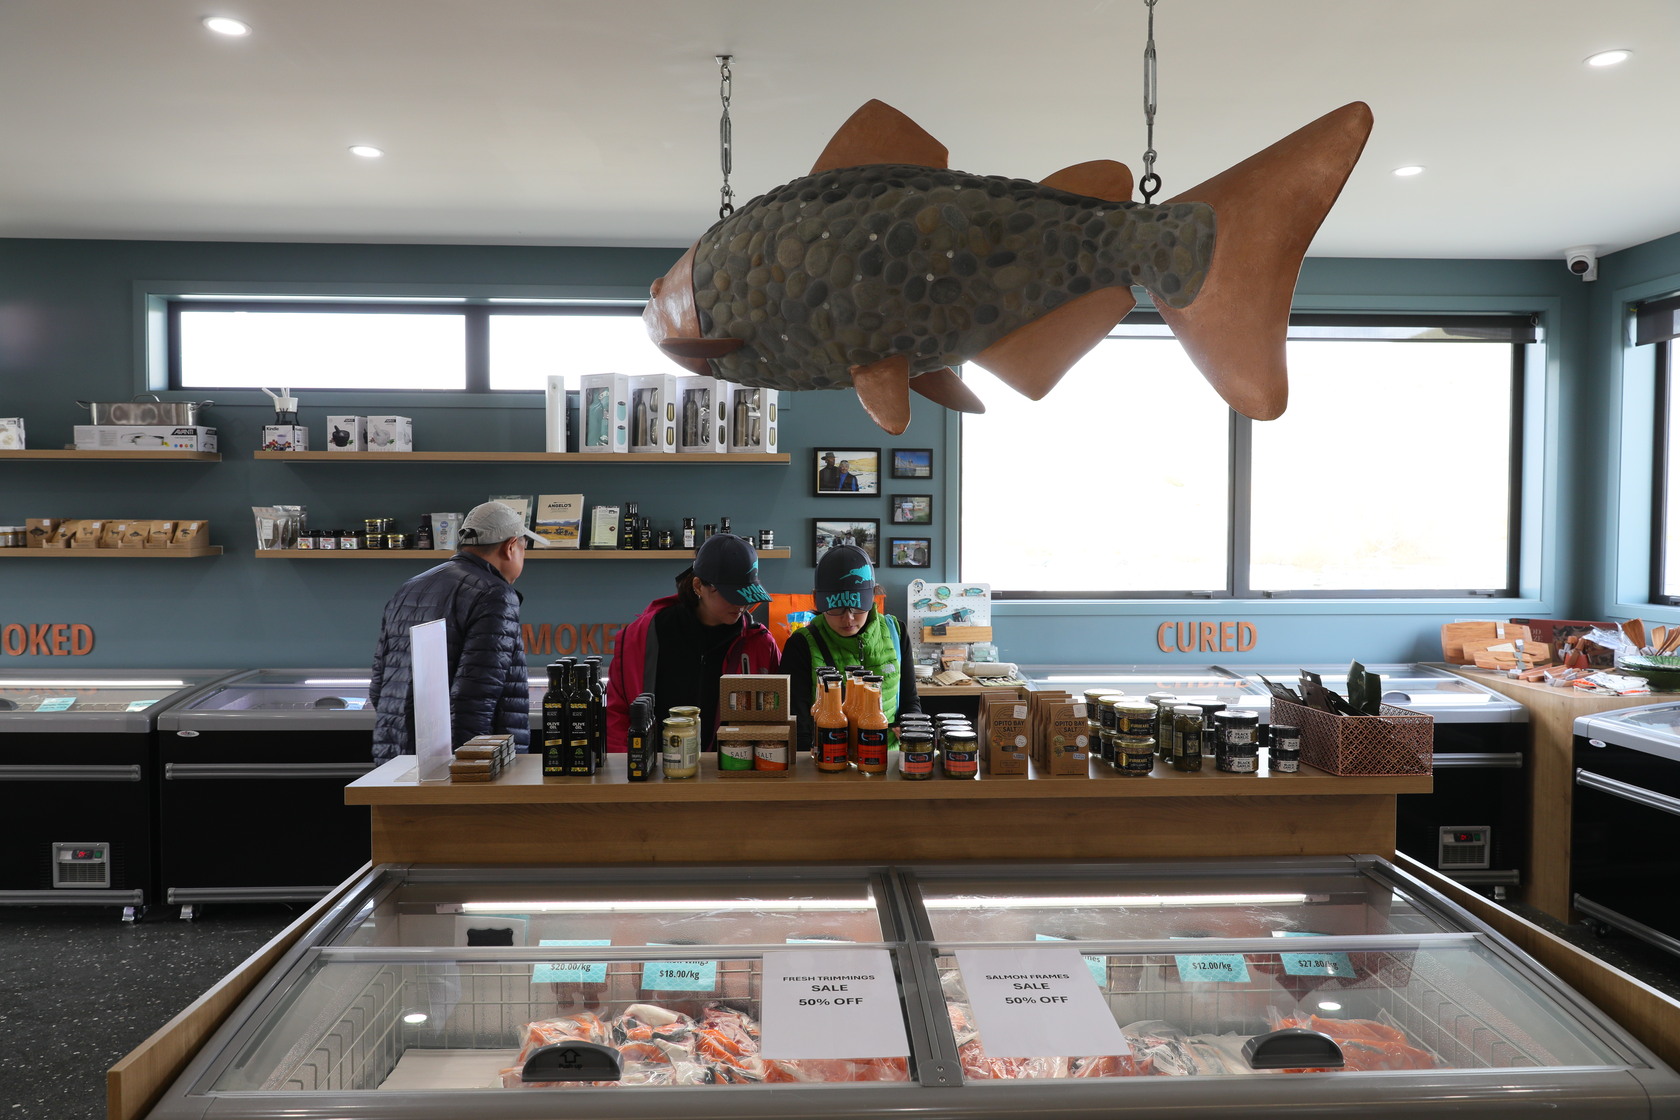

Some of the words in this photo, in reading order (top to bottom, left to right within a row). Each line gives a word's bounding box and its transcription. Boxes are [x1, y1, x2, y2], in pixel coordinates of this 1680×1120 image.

[0, 623, 95, 656] OKED
[521, 623, 630, 655] MOKE
[1157, 621, 1258, 653] CURED
[757, 751, 773, 759] SALT
[550, 963, 591, 972] $20.00/kg
[1192, 962, 1233, 972] $12.00/kg
[1298, 960, 1339, 970] $27.80/kg
[659, 970, 700, 980] $18.00/kg
[811, 984, 848, 992] SALE
[798, 998, 830, 1006] 50%
[1005, 996, 1037, 1004] 50%
[1039, 996, 1069, 1004] OFF
